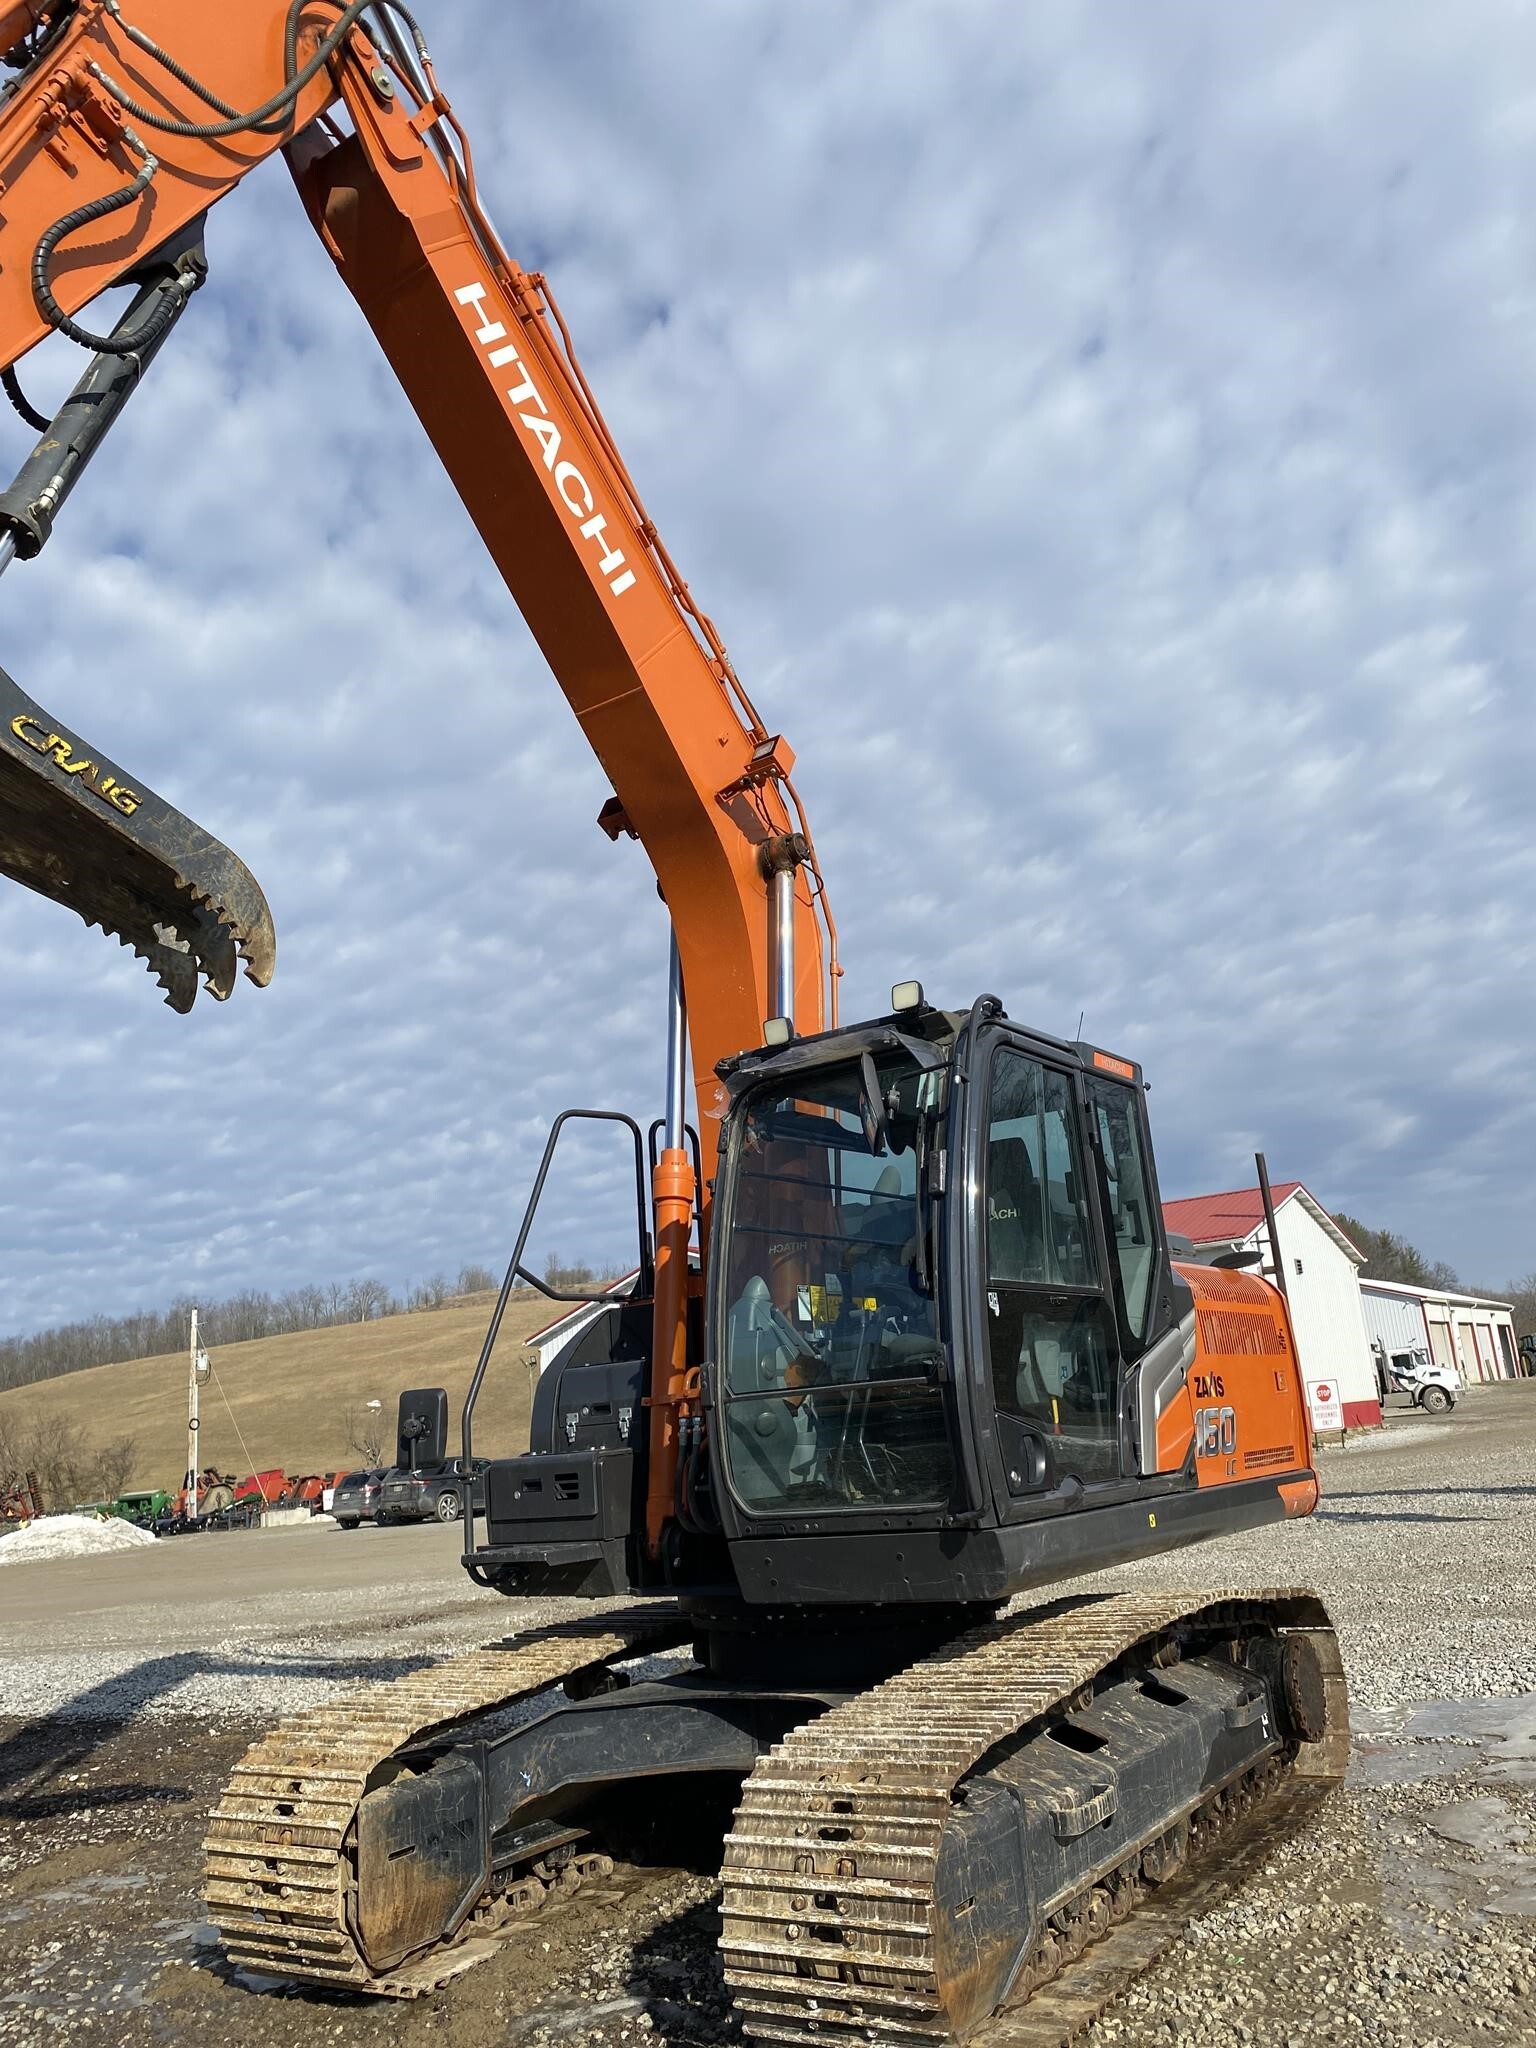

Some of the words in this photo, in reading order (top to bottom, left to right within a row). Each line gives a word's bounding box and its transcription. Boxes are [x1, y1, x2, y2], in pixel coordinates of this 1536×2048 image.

[454, 281, 637, 597] HITACHI
[10, 715, 143, 819] CRAIG
[1194, 1406, 1236, 1459] 160
[1317, 1389, 1331, 1398] STOP
